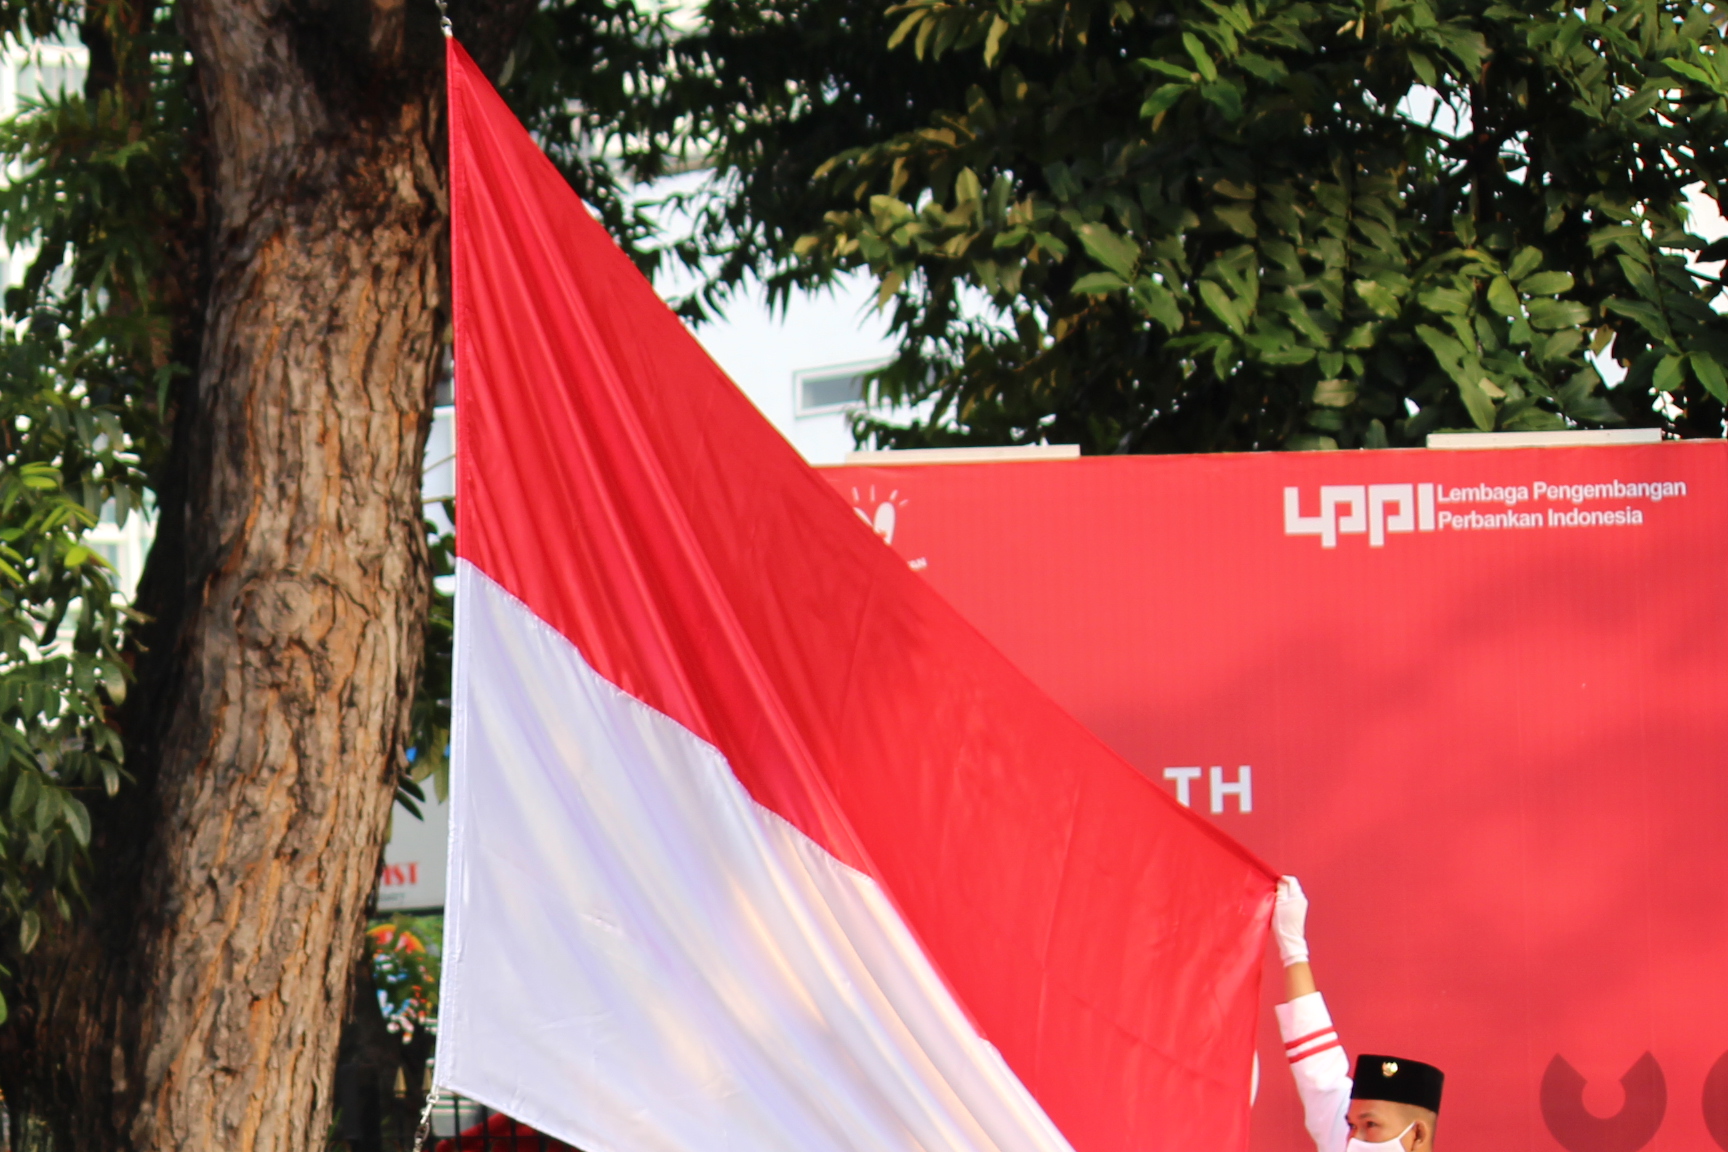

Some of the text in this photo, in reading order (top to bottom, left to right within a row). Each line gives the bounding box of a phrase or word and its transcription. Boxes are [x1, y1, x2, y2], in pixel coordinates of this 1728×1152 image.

[1437, 479, 1687, 505] Lembaga Pengembangan
[1438, 506, 1644, 531] Perbankan Indonesia
